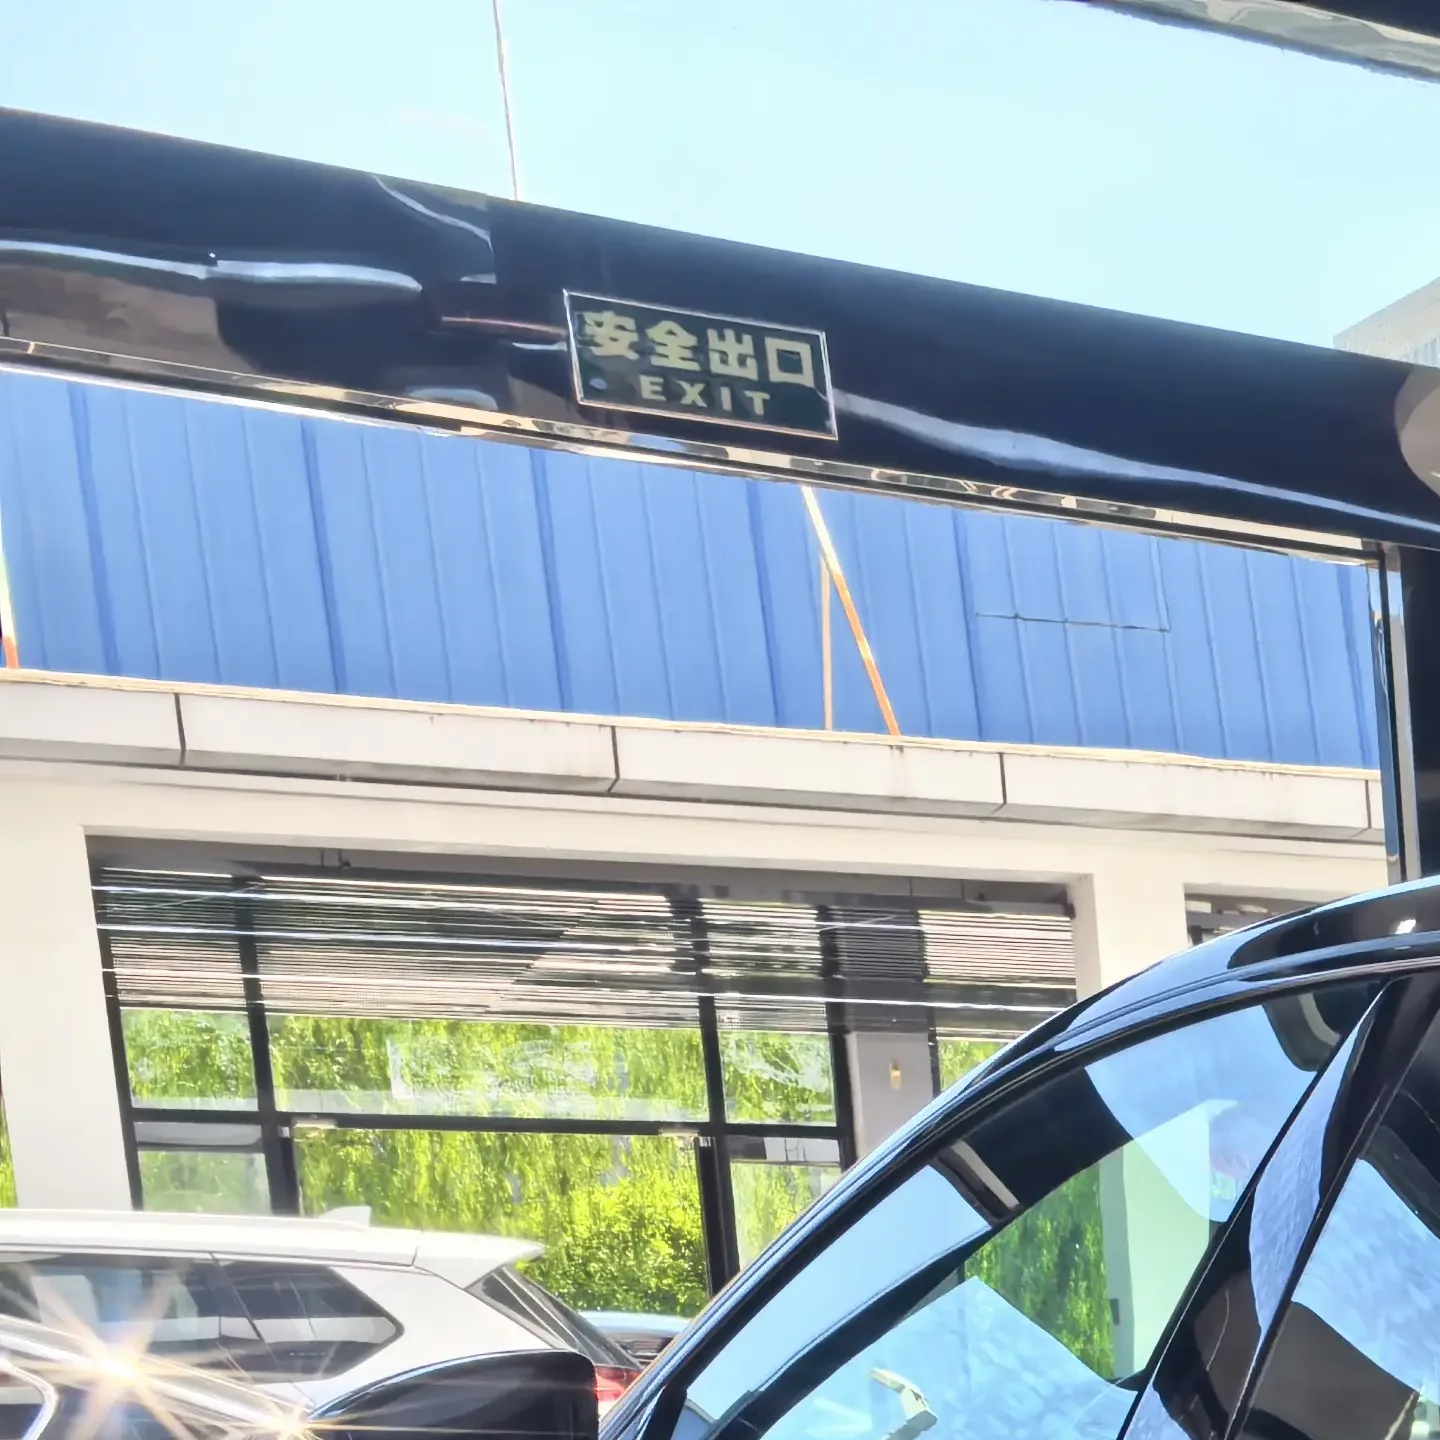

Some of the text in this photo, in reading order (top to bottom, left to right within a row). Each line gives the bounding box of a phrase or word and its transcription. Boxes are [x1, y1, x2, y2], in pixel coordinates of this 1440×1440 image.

[580, 309, 815, 387] 安全出口
[638, 374, 771, 417] EXIT
